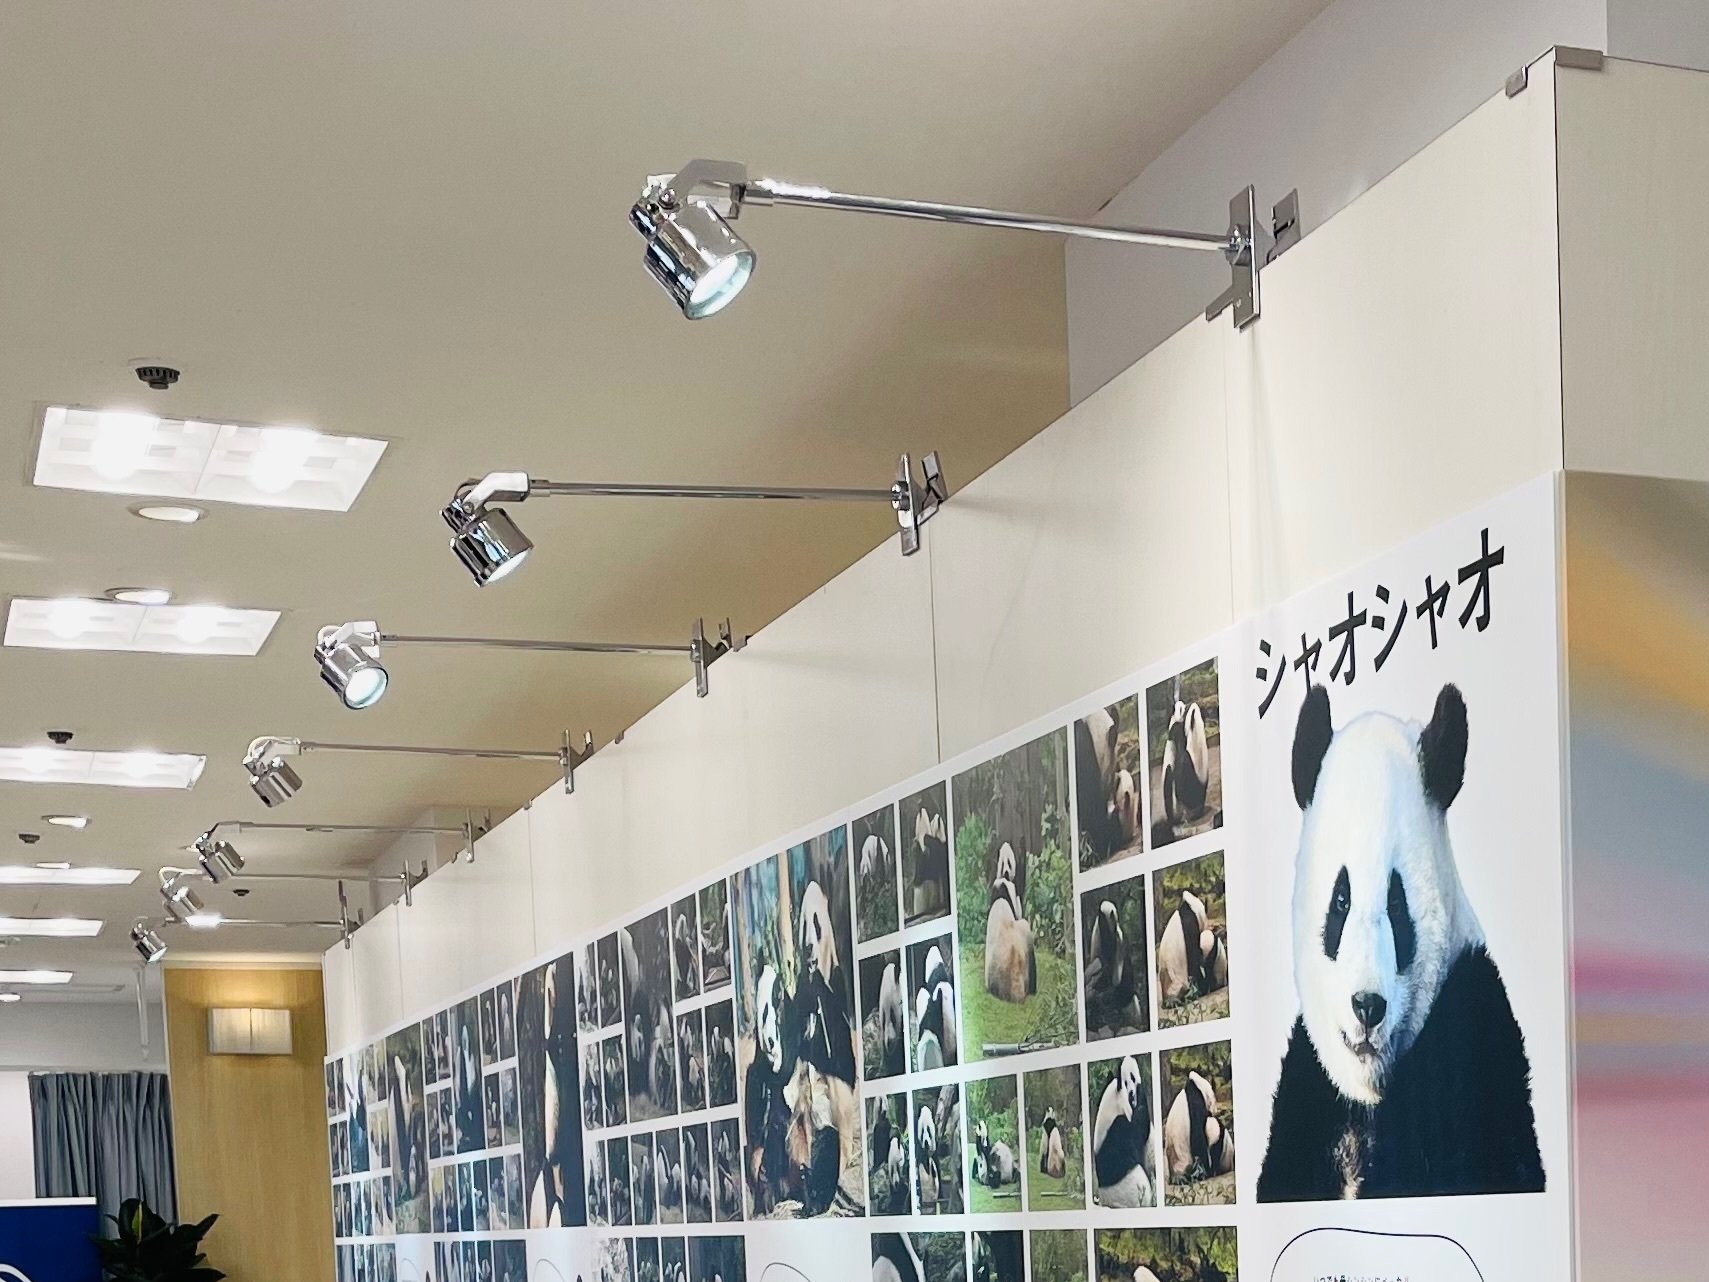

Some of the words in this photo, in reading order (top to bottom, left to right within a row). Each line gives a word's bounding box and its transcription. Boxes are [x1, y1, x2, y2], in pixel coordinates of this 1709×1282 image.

[1256, 528, 1504, 719] シャオシャオ
